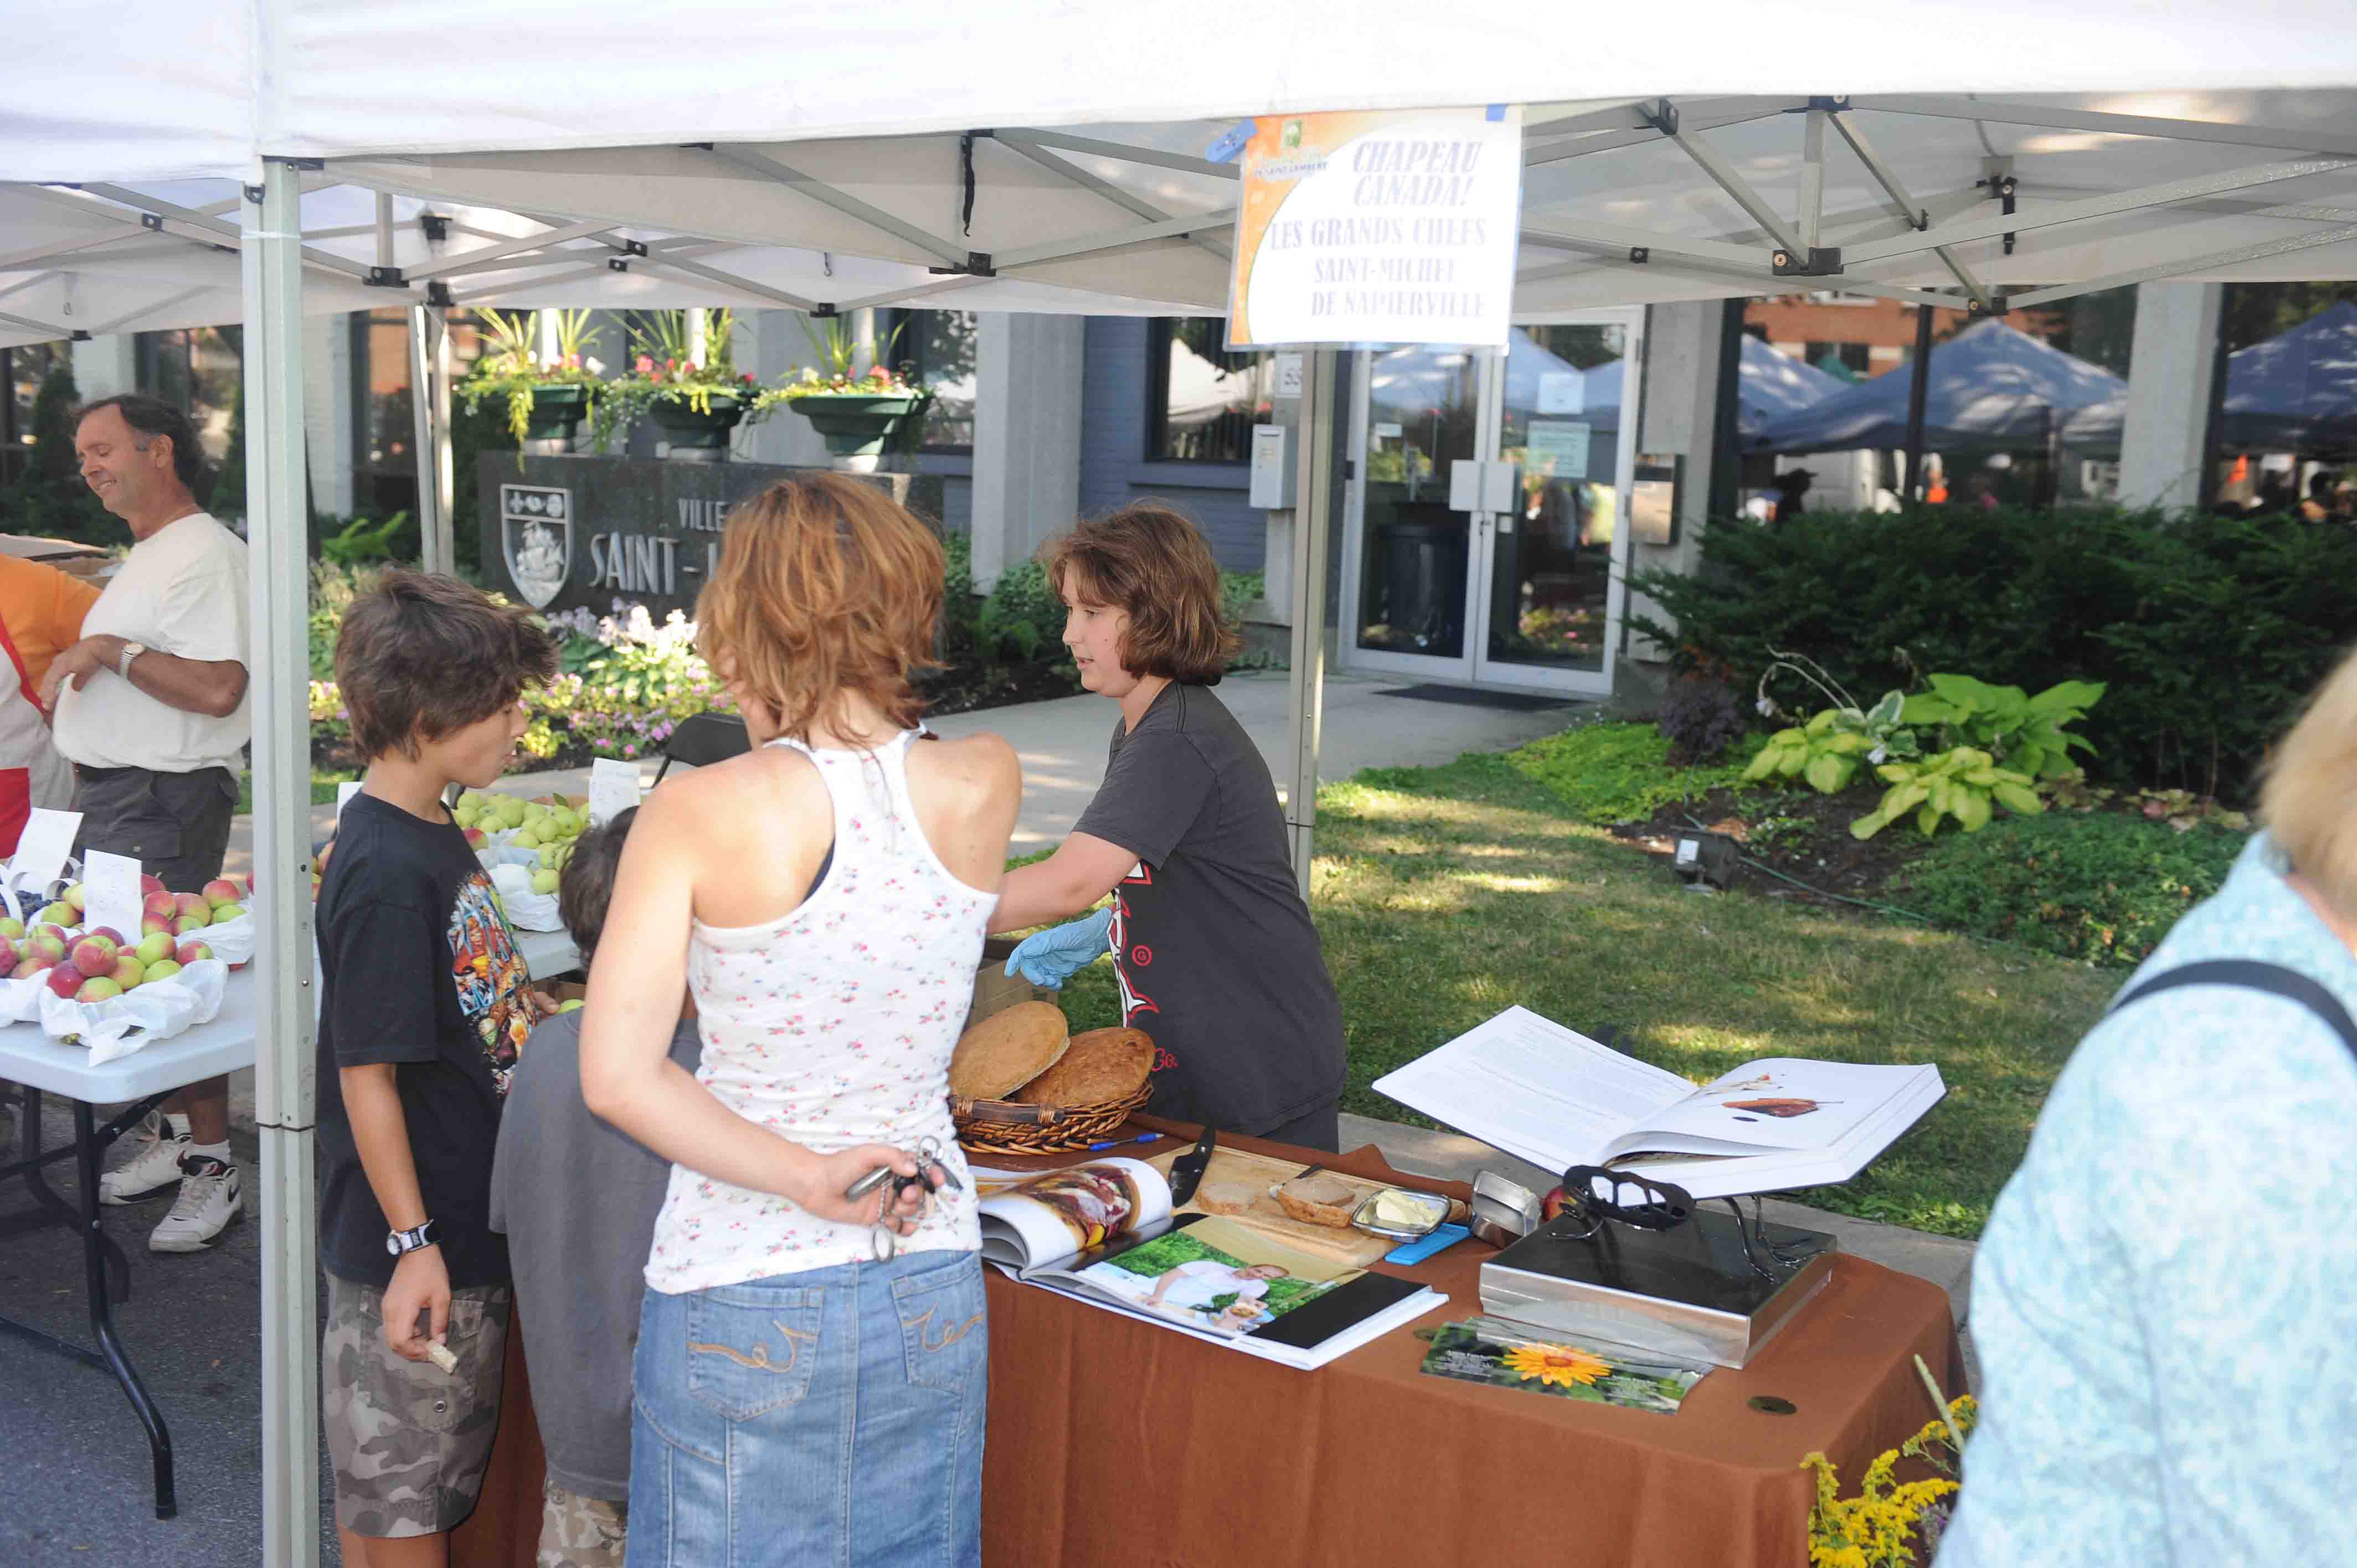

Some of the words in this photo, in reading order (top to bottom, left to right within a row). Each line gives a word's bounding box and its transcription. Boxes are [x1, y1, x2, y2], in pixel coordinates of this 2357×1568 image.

[1354, 140, 1483, 173] CHAPEAU
[1354, 174, 1474, 206] CANADA!
[1270, 220, 1303, 250] LES
[1311, 217, 1403, 246] GRANDS
[1413, 216, 1488, 246] CHEFS
[1311, 291, 1338, 318] DE
[1345, 290, 1486, 318] NAPIERVILLE
[678, 497, 730, 532] VILLE
